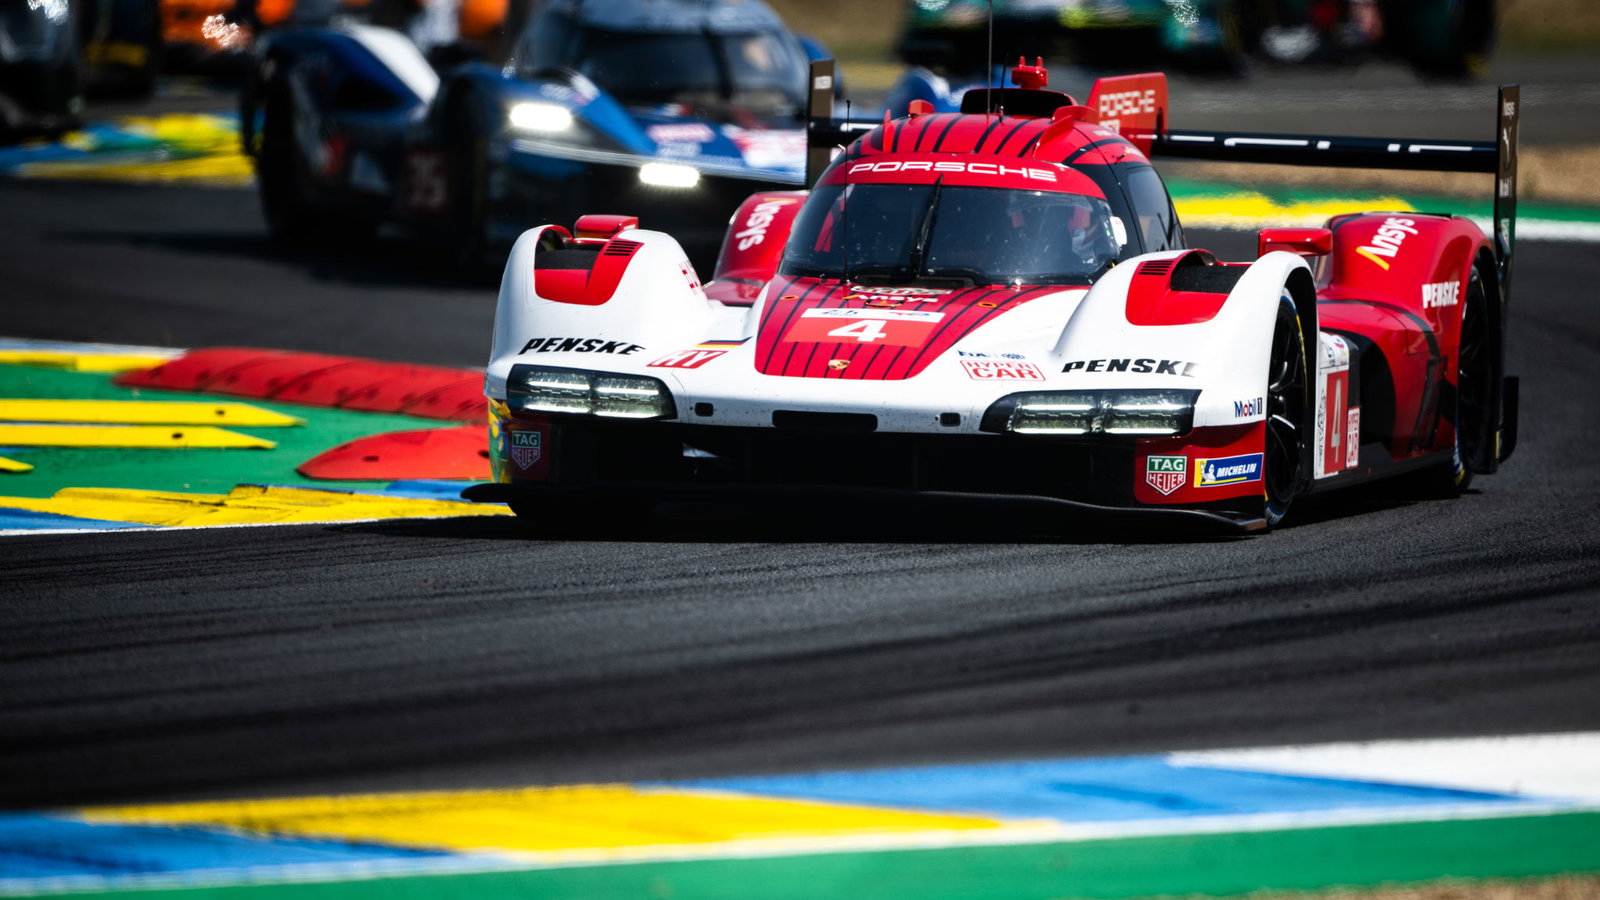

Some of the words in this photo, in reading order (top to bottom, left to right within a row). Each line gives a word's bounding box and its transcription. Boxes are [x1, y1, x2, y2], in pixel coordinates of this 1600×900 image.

[1099, 89, 1155, 118] PORSCHE
[848, 161, 1057, 182] PORSCHE
[1356, 217, 1419, 271] Ansys
[842, 294, 939, 303] Ansys
[1422, 280, 1460, 309] PENSKE
[827, 319, 888, 342] 4
[517, 337, 646, 355] PENSKE
[966, 361, 1032, 369] HYPER
[972, 368, 1038, 379] CAR
[1234, 399, 1256, 418] Mobil
[1331, 378, 1341, 463] 4
[514, 433, 537, 446] TAG
[512, 448, 539, 467] HEUER
[1151, 457, 1183, 470] TAG
[1216, 463, 1257, 478] MICHELIN
[1148, 472, 1185, 491] HEUER
